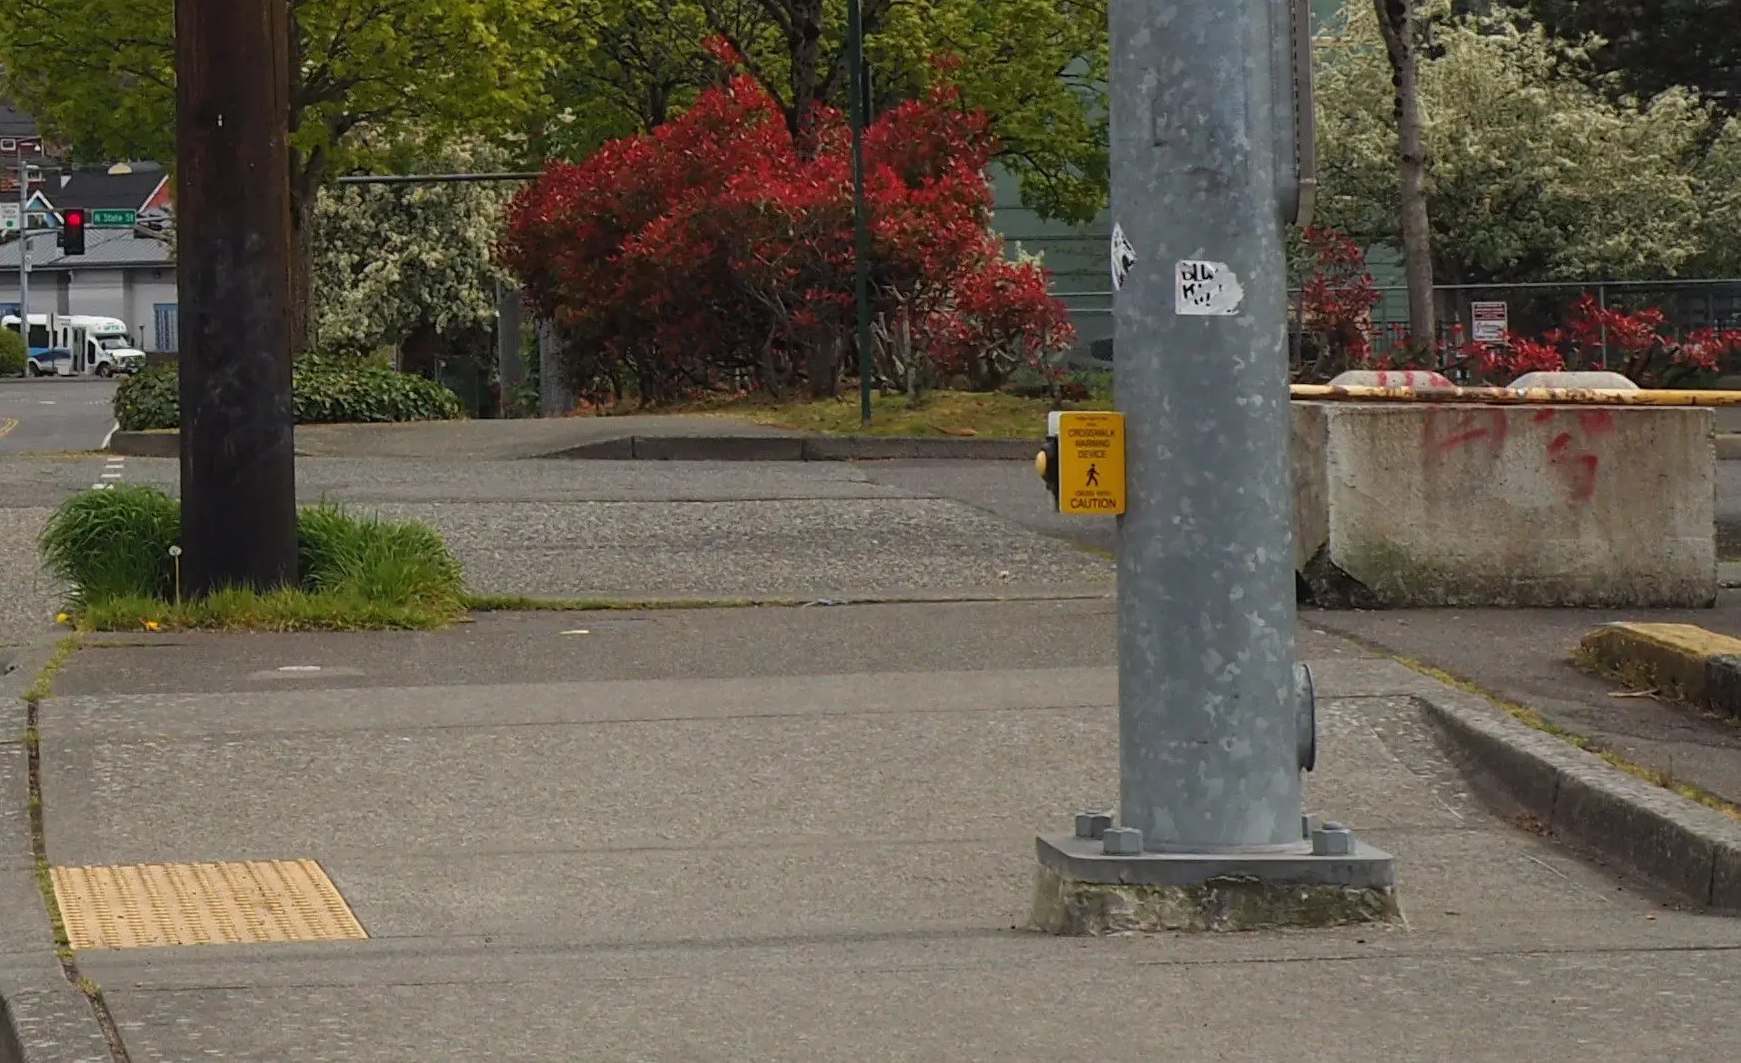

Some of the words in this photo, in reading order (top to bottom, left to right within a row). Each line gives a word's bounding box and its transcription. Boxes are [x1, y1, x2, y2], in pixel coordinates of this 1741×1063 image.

[103, 213, 123, 222] State
[1067, 429, 1115, 437] CROSSWALK
[1075, 439, 1111, 448] WARNING
[1078, 450, 1107, 459] DEVICE
[1070, 498, 1117, 509] CAUTION
